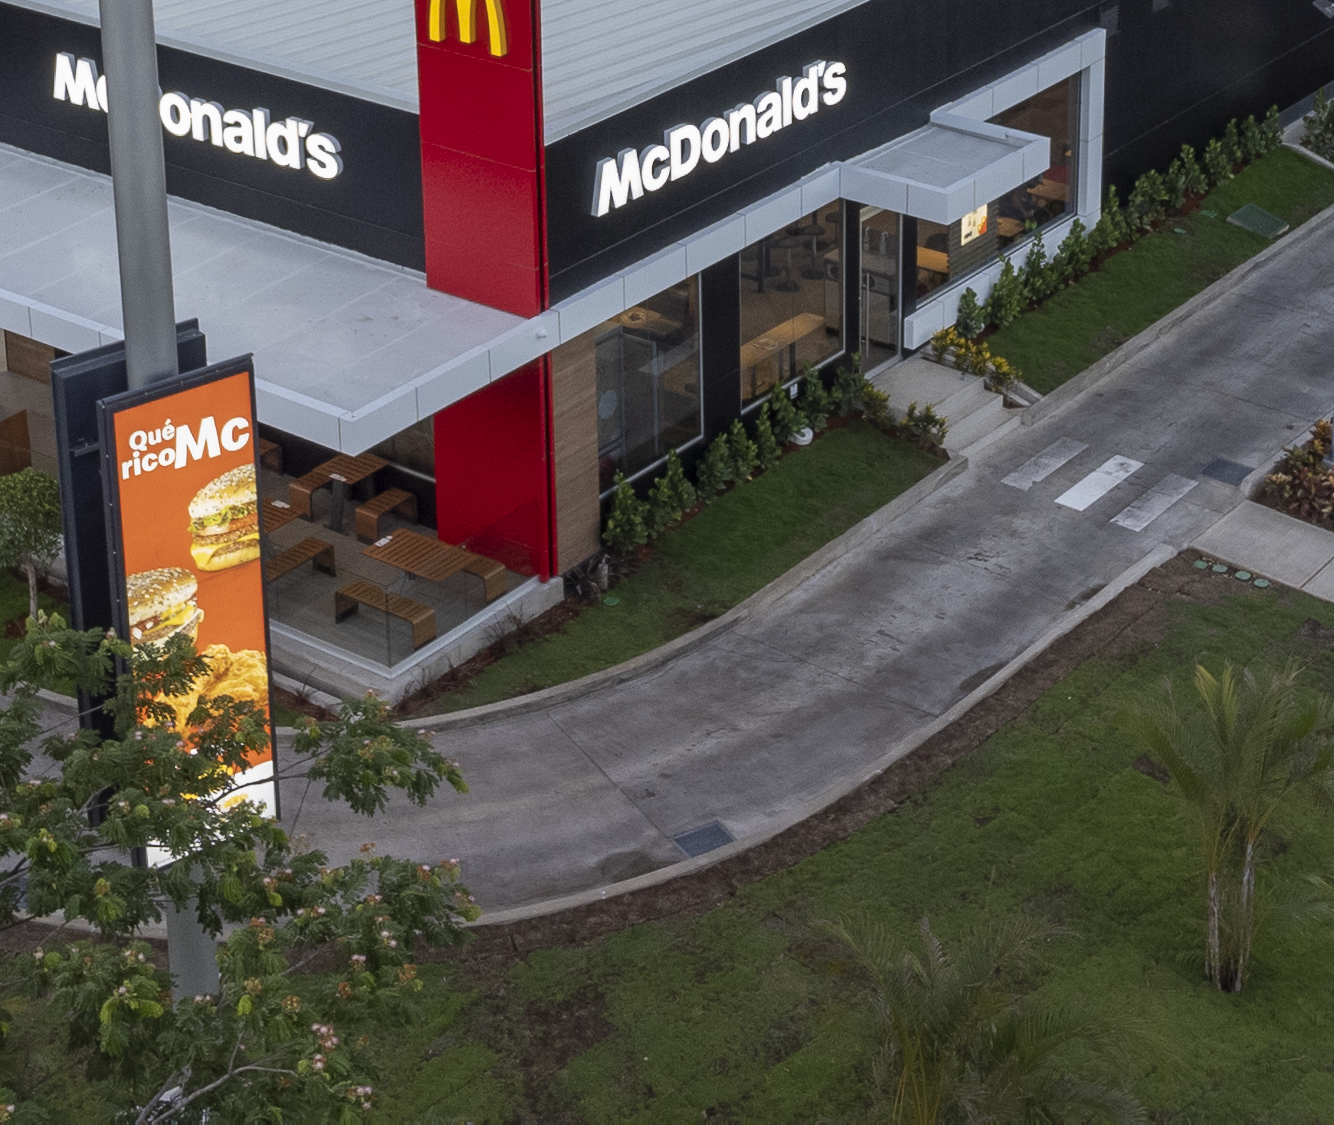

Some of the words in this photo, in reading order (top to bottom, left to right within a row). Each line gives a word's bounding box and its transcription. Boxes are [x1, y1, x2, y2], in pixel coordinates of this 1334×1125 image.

[53, 52, 343, 179] Monald's
[591, 59, 847, 217] McDonald's
[121, 450, 176, 480] rico
[129, 418, 175, 451] Qué
